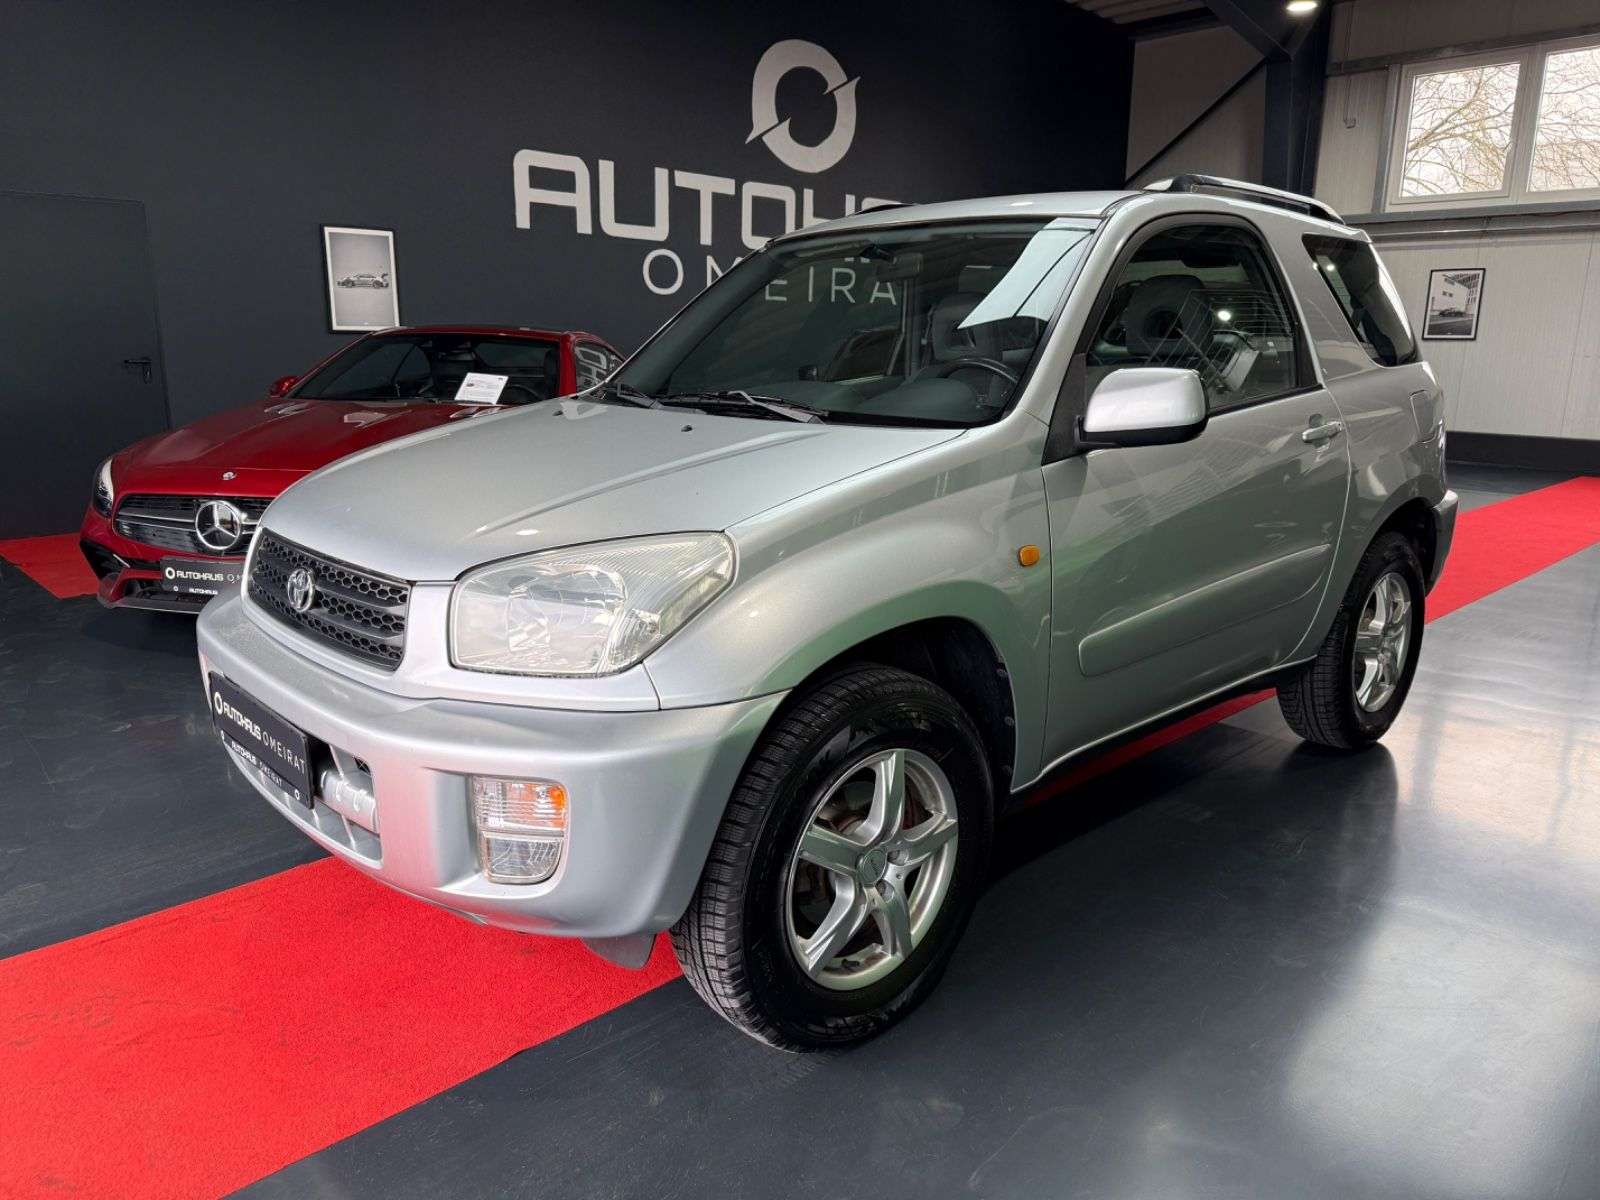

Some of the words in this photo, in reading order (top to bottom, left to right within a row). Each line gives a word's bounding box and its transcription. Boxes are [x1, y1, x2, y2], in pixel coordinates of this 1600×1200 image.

[176, 570, 224, 581] AUTOHAUS
[223, 701, 262, 741] AUTOHAUS
[262, 731, 305, 775] OMEIRAT
